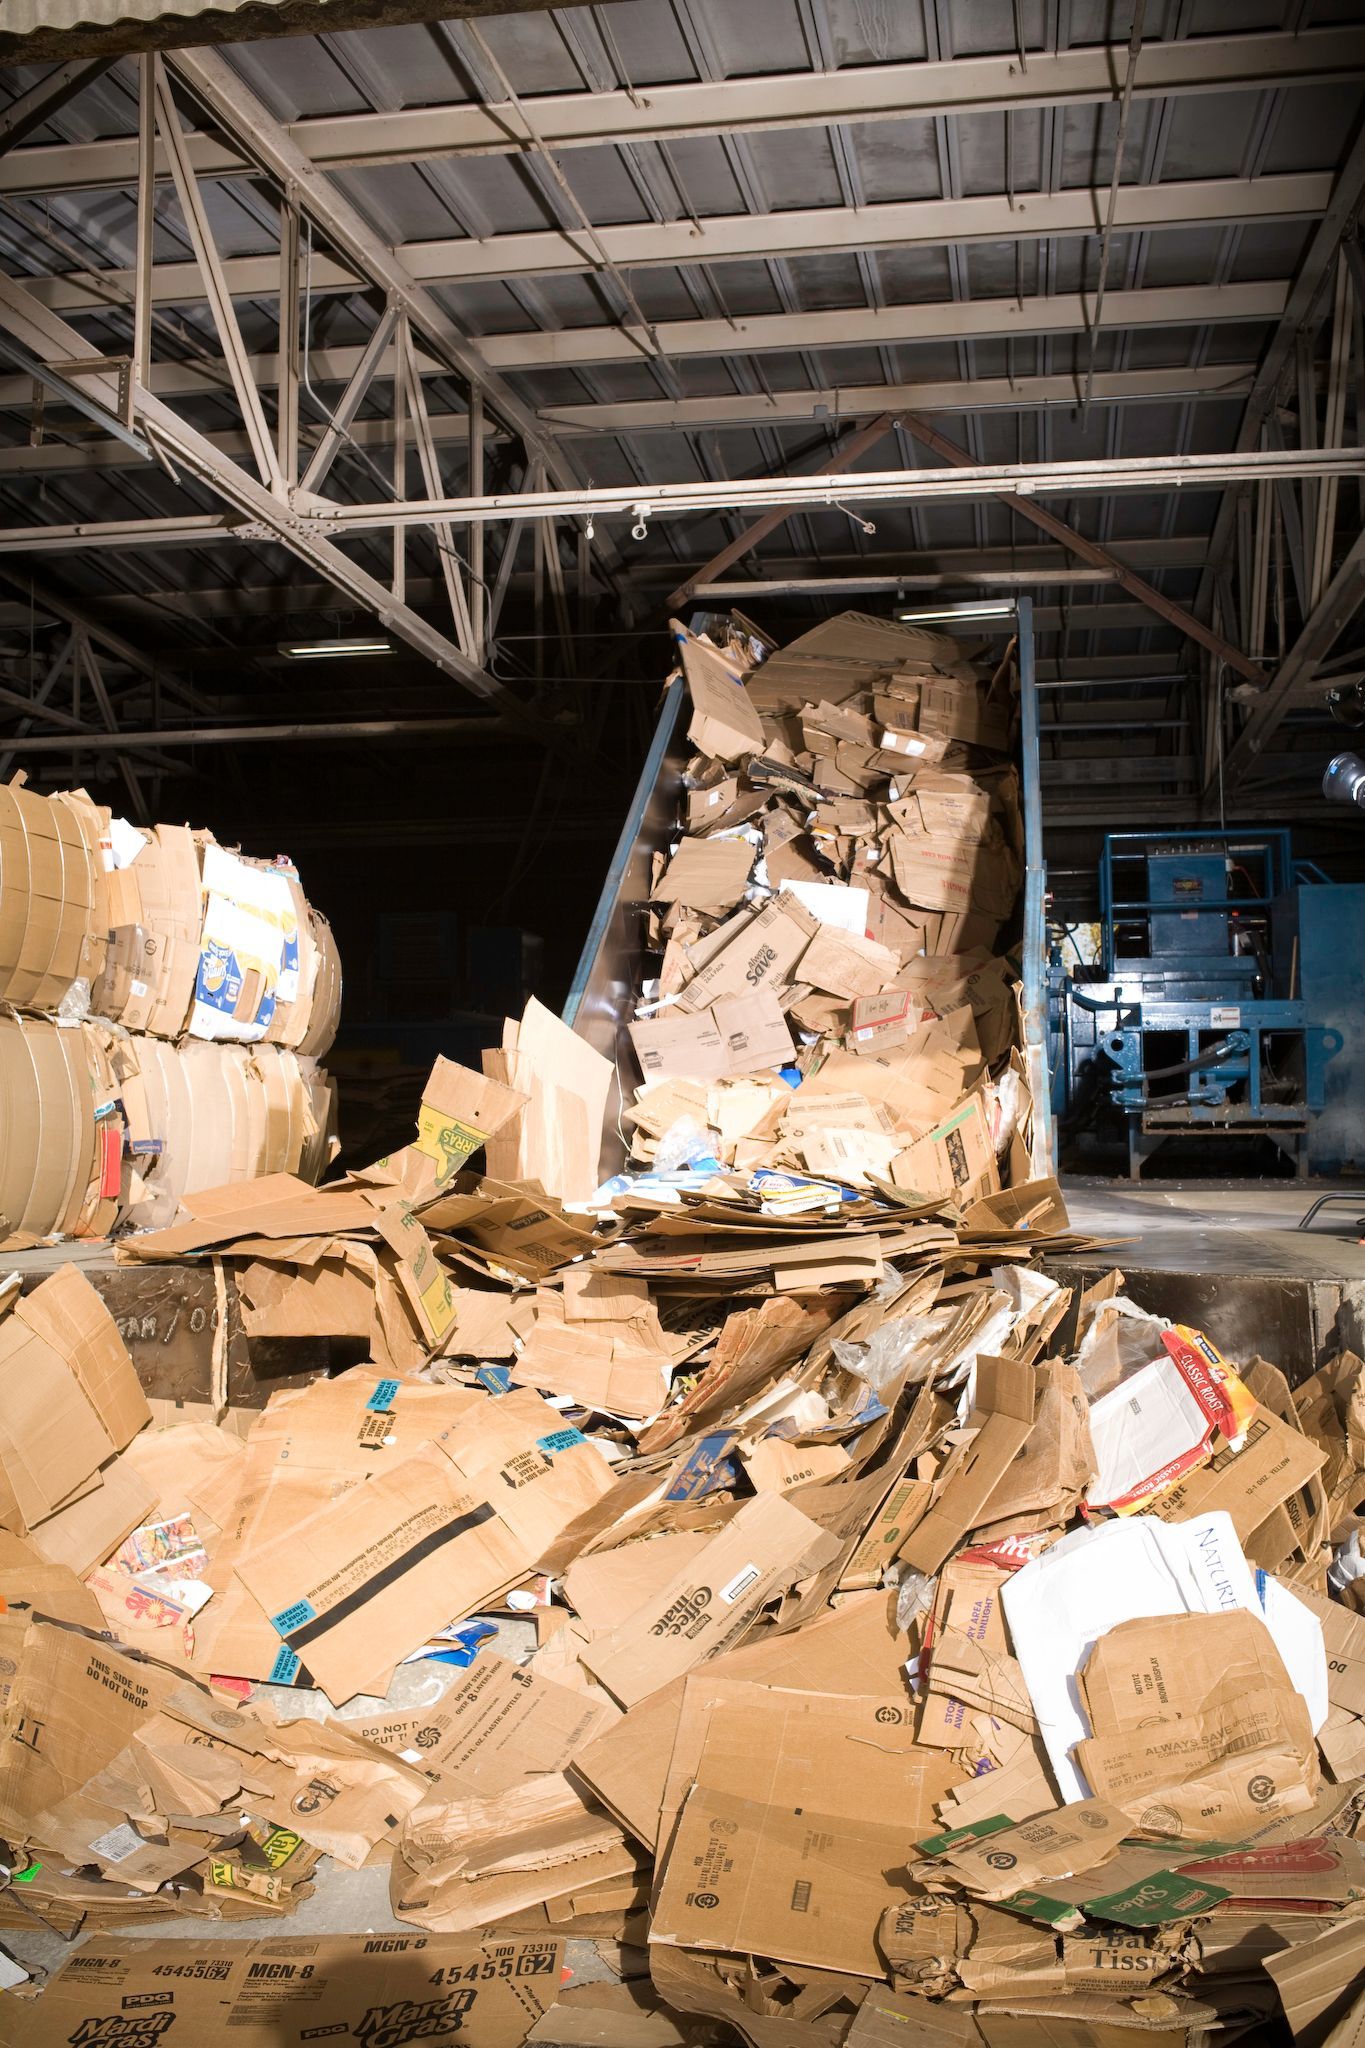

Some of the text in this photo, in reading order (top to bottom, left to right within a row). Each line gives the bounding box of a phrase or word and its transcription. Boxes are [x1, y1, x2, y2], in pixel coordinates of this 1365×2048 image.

[745, 947, 778, 987] Save
[748, 942, 770, 967] Always
[1180, 1354, 1208, 1388] CLASSIC
[1200, 1385, 1224, 1413] ROAST
[518, 1463, 538, 1478] PLEASE
[1153, 1463, 1182, 1488] CLASSIC
[1163, 1485, 1188, 1510] CARE
[1194, 1526, 1238, 1612] NATURE
[972, 1600, 984, 1626] AREA
[976, 1597, 994, 1640] SUNLIGHT
[90, 1656, 149, 1696] THIS SIDE UP
[472, 1665, 488, 1683] STACK
[521, 1674, 535, 1689] UP
[1150, 1656, 1169, 1704] BROWN DISPLAY
[86, 1666, 148, 1710] DO NOT DROP
[455, 1700, 469, 1715] OVER
[474, 1673, 492, 1694] LAYERS
[490, 1660, 503, 1675] HIGH
[483, 1715, 503, 1738] PLASTIC
[501, 1692, 522, 1716] BOTTLES
[362, 1722, 410, 1738] DO NOT
[373, 1735, 393, 1745] CUT
[1145, 1726, 1233, 1756] ALWAYS SAVE
[431, 1773, 442, 1783] UP
[1200, 1805, 1222, 1817] GM-7
[1110, 1884, 1169, 1912] Sides
[895, 1910, 915, 1935] PACK
[363, 1938, 428, 1954] MGN-8
[494, 1943, 558, 1957] 100 73310
[70, 1958, 121, 1968] MGN-8
[247, 1963, 315, 1979] MGN-8
[126, 1993, 172, 2005] PDQ
[353, 1989, 478, 2037] Mardi
[70, 2012, 176, 2043] Mardi
[303, 2026, 347, 2039] PDQ
[361, 2010, 463, 2048] Gras
